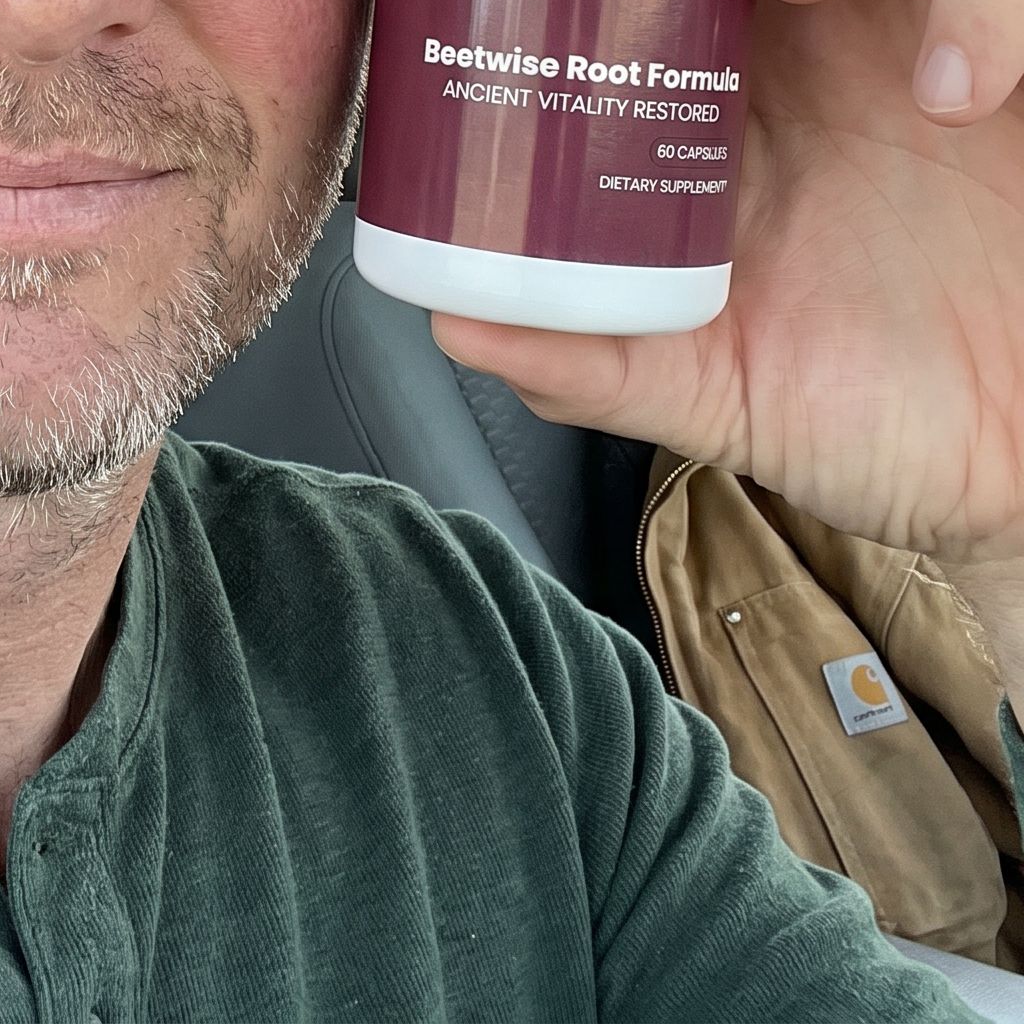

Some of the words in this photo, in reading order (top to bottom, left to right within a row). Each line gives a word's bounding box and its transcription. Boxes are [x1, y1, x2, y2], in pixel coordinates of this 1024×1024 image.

[423, 38, 560, 78] Beetwise
[566, 55, 642, 87] Root
[646, 63, 740, 92] Formula
[442, 79, 533, 108] ANCIENT
[537, 90, 629, 118] VITALITY
[633, 100, 720, 123] RESTORED
[657, 144, 675, 159] 60
[599, 175, 658, 192] DIETARY
